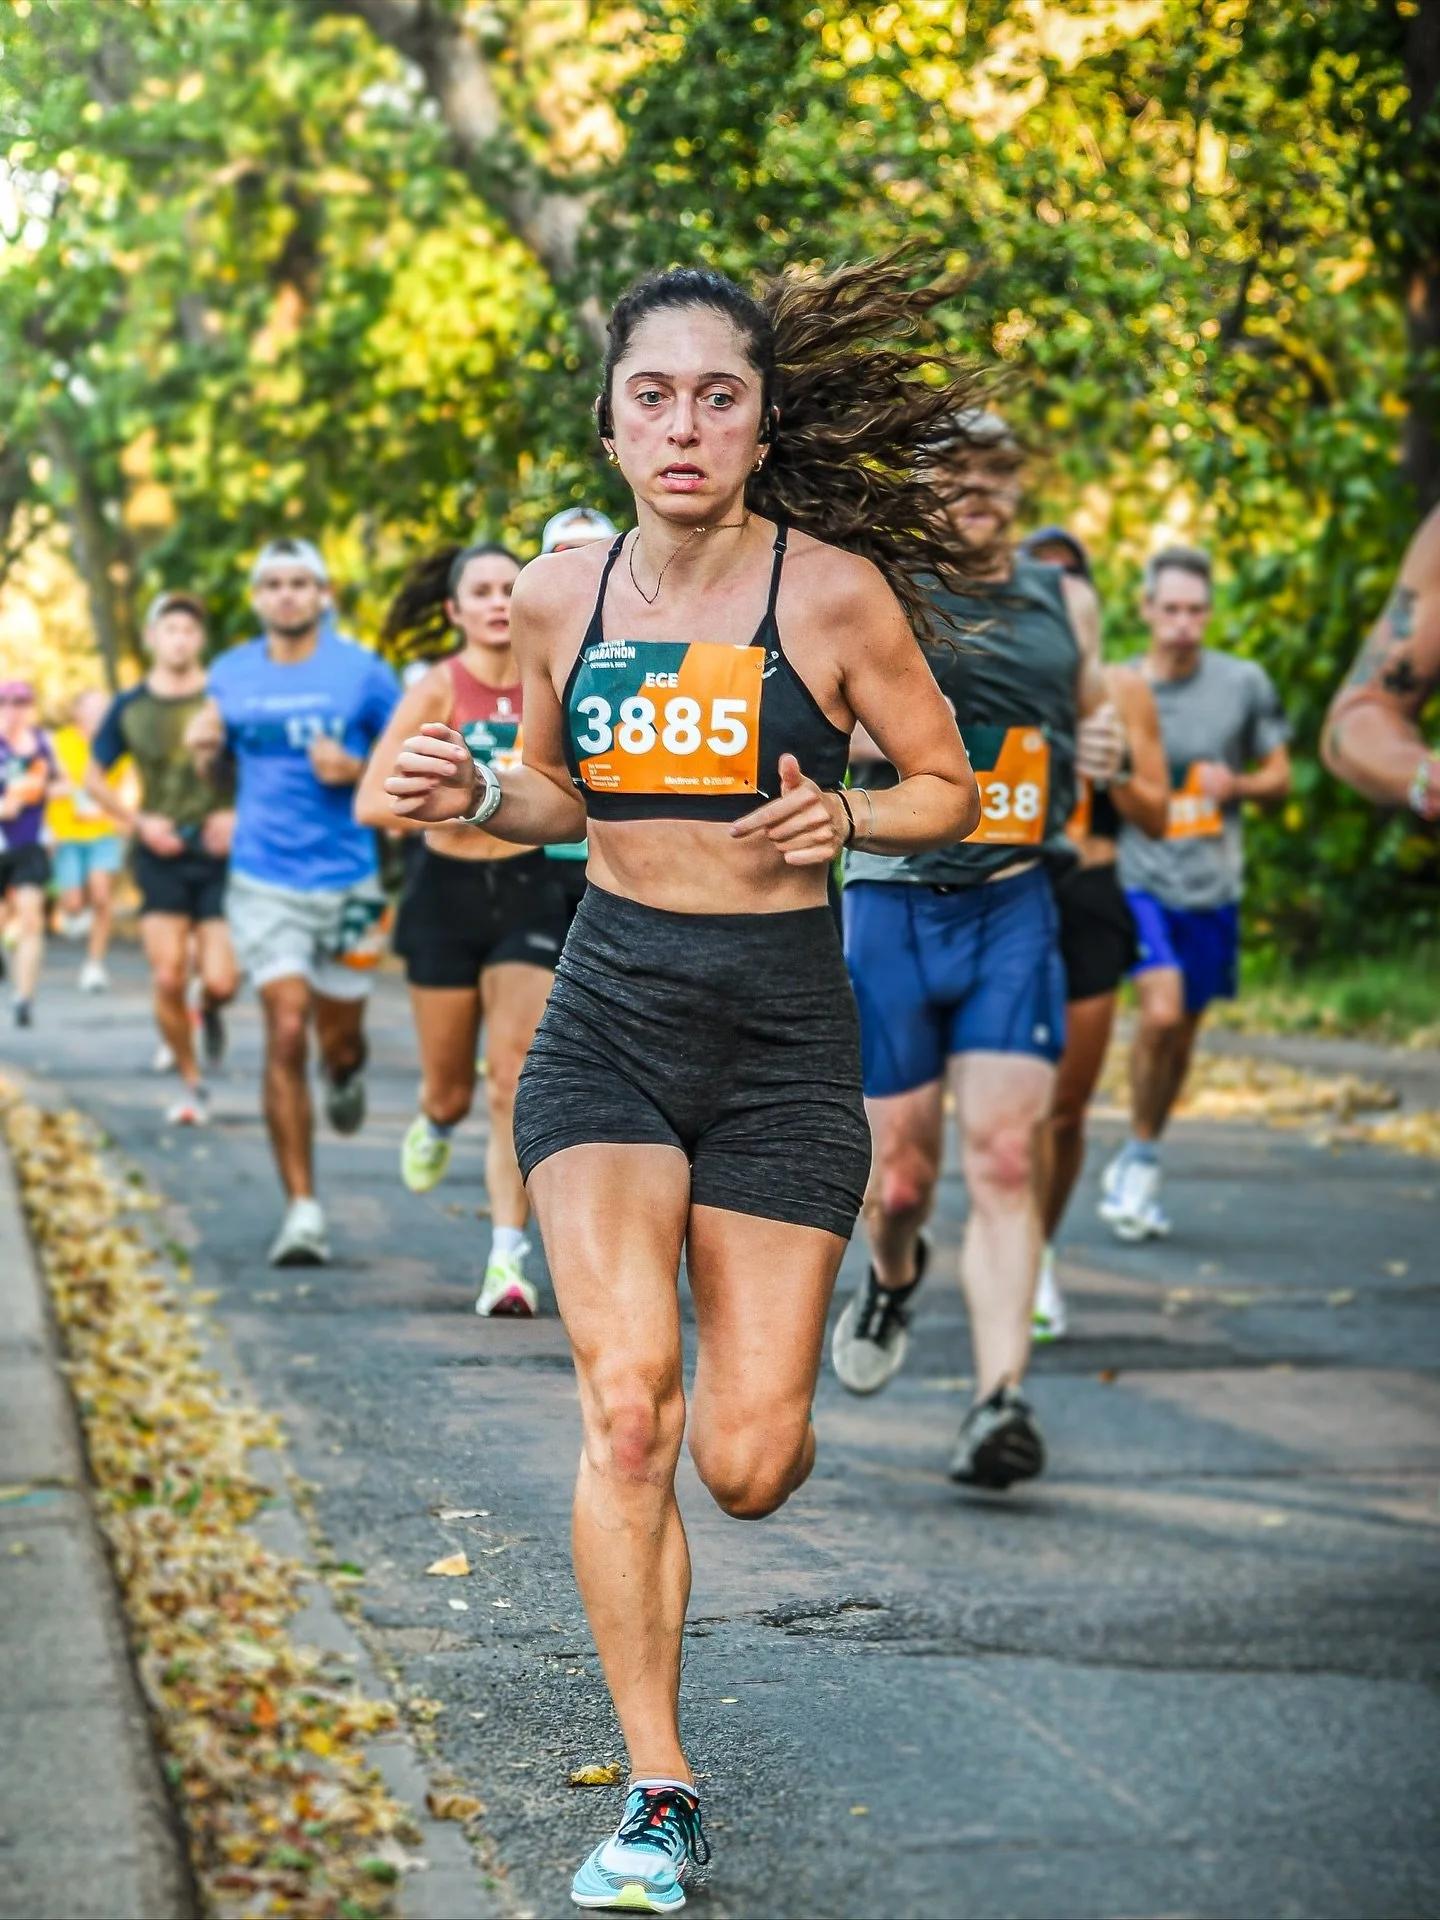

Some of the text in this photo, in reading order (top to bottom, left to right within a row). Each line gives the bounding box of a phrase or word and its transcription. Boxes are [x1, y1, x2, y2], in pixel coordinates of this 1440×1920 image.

[588, 646, 636, 662] MARATHON
[645, 672, 679, 688] ECE
[576, 695, 748, 756] 3885
[976, 781, 1041, 822] 38
